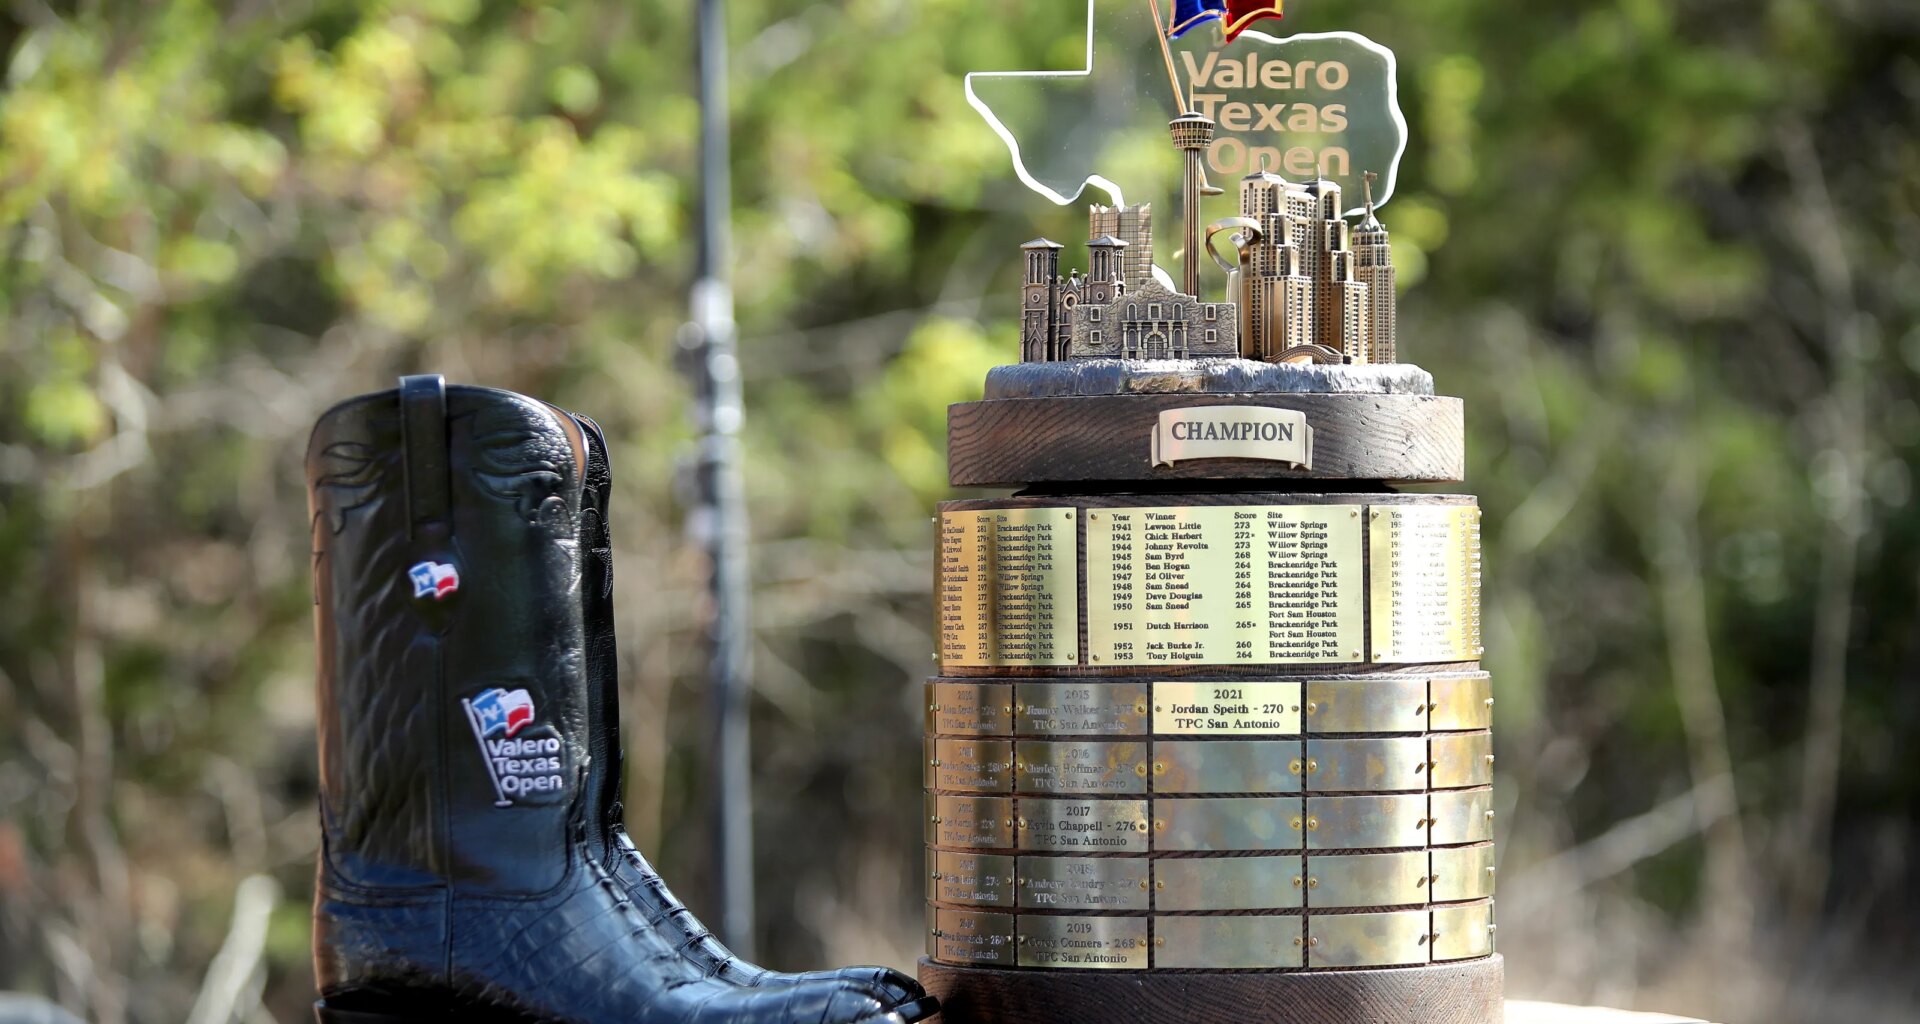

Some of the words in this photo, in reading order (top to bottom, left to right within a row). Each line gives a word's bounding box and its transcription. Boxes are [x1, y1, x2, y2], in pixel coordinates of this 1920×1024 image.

[1181, 51, 1349, 90] Valero
[1193, 94, 1348, 133] Texas
[1207, 137, 1350, 176] Open
[1172, 422, 1294, 441] CHAMPION
[1112, 513, 1131, 521] Year
[1144, 513, 1176, 521] Winner
[1234, 511, 1257, 519] Score
[1267, 511, 1283, 519] Site
[1112, 523, 1132, 531] 1941
[1234, 521, 1251, 529] 273
[1300, 521, 1328, 530] Springs
[1112, 533, 1132, 541] 1942
[1144, 532, 1169, 541] Chick
[1300, 531, 1328, 540] Springs
[1112, 543, 1132, 551] 1944
[1145, 543, 1174, 551] Johnny
[1234, 541, 1251, 549] 273
[1300, 541, 1328, 550] Springs
[1112, 553, 1132, 561] 1945
[1145, 552, 1162, 561] Sam
[1164, 552, 1185, 561] Byrd
[1234, 551, 1251, 559] 268
[1300, 551, 1328, 560] Springs
[1112, 563, 1132, 571] 1946
[1145, 562, 1161, 570] Ben
[1163, 562, 1190, 572] Hogan
[1235, 561, 1251, 569] 264
[1268, 561, 1319, 570] Brackenridge
[1321, 560, 1338, 568] Park
[1112, 573, 1132, 581] 1947
[1145, 572, 1157, 581] Ed
[1158, 572, 1185, 580] Oliver
[1268, 571, 1319, 580] Brackenridge
[1112, 583, 1133, 591] 1948
[1145, 582, 1163, 590] Sam
[1164, 582, 1189, 590] Snead
[1268, 581, 1319, 590] Brackenridge
[1113, 592, 1133, 601] 1949
[1145, 592, 1167, 600] Dave
[1169, 592, 1203, 601] Douglas
[1235, 591, 1252, 599] 268
[1268, 591, 1319, 600] Brackenridge
[1113, 602, 1133, 611] 1950
[1145, 602, 1163, 610] Sam
[1165, 602, 1189, 610] Snead
[1268, 601, 1319, 610] Brackenridge
[1268, 610, 1285, 618] Fort
[1287, 610, 1304, 618] Sam
[1113, 622, 1133, 631] 1951
[1146, 622, 1171, 630] Dutch
[1173, 622, 1209, 630] Harrison
[1269, 620, 1319, 629] Brackenridge
[1321, 620, 1338, 628] Park
[1269, 630, 1285, 638] Fort
[1287, 630, 1304, 638] Sam
[1306, 630, 1337, 638] Houston
[1114, 642, 1133, 650] 1952
[1146, 642, 1164, 650] Jack
[1167, 642, 1192, 650] Burke
[1236, 641, 1252, 649] 260
[1269, 640, 1320, 649] Brackenridge
[1322, 640, 1339, 648] Park
[1114, 652, 1134, 660] 1953
[1146, 652, 1168, 661] Tony
[1236, 651, 1252, 659] 264
[1269, 650, 1320, 659] Brackenridge
[1065, 690, 1089, 700] 2015
[1214, 690, 1243, 699] 2021
[1062, 705, 1100, 715] Walker
[1171, 704, 1209, 713] Jordan
[1213, 704, 1249, 715] Speith
[1263, 704, 1284, 713] 270
[1061, 721, 1077, 729] San
[1175, 719, 1203, 728] TPC
[1207, 719, 1228, 728] San
[1233, 719, 1280, 728] Antonio
[487, 738, 560, 756] Valero
[492, 757, 560, 775] Texas
[501, 775, 562, 797] Open
[1060, 779, 1078, 788] San
[1066, 807, 1090, 816] 2017
[1059, 821, 1102, 832] Chappell
[1116, 822, 1136, 831] 276
[1061, 835, 1078, 845] San
[1083, 836, 1127, 845] Antonio
[1035, 893, 1056, 903] TPC
[1067, 924, 1091, 933] 2019
[1061, 938, 1102, 948] Conners
[1114, 939, 1135, 948] 268
[1061, 953, 1080, 962] San
[1084, 953, 1127, 963] Antonio
